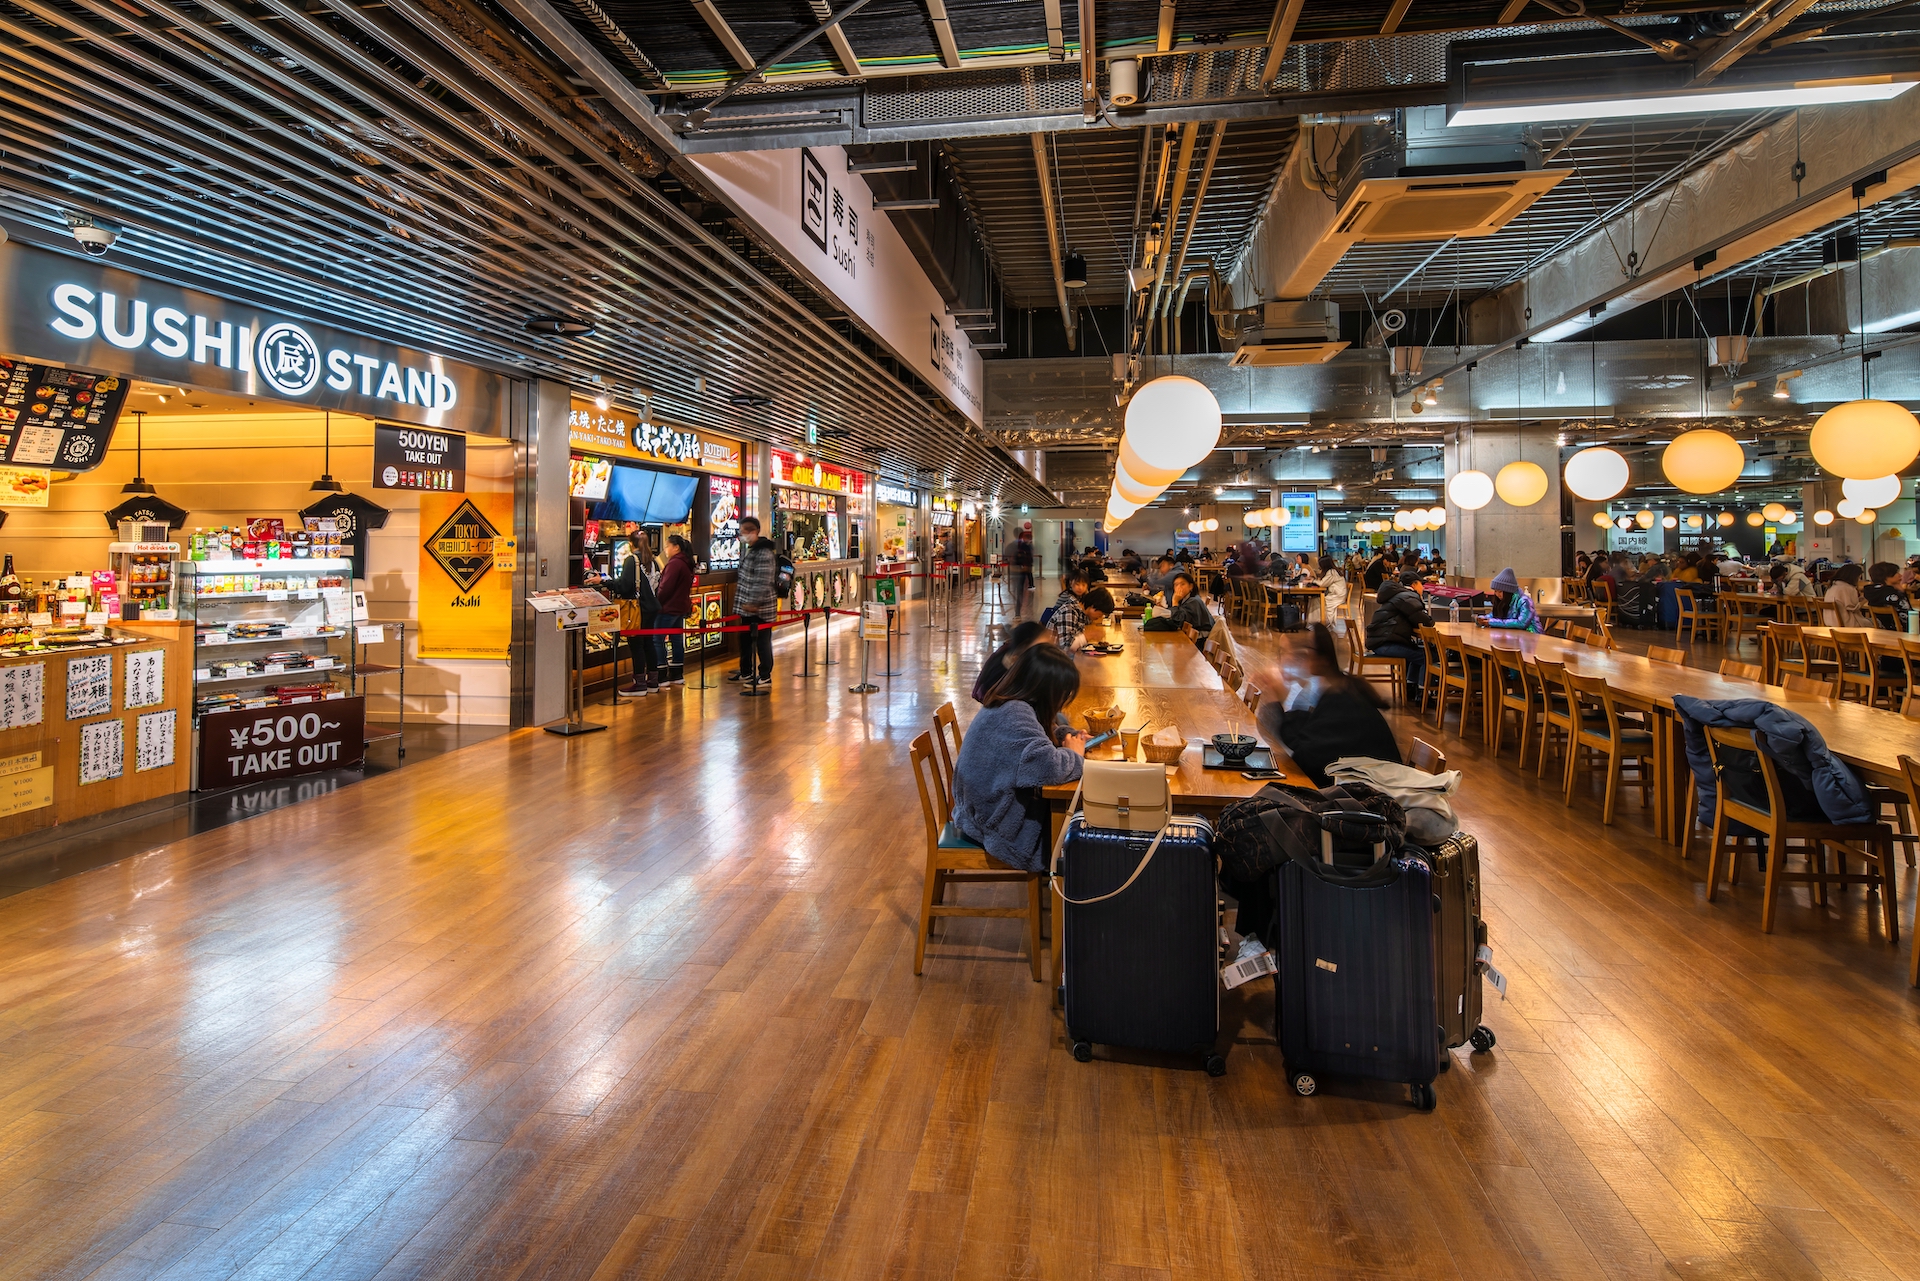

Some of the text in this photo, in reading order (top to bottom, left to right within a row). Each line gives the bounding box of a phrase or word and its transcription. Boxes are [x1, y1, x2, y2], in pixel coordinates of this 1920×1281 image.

[833, 186, 858, 246] 寿司
[833, 234, 856, 280] Sushi
[51, 283, 457, 411] SUSHI 辰 STAND
[70, 434, 96, 444] TATSU
[398, 429, 449, 453] 500YEN
[63, 454, 89, 463] SUSHI
[405, 450, 443, 465] TAKE OUT
[792, 465, 814, 487] ONE
[134, 509, 156, 518] TATSU
[331, 507, 354, 517] TATSU
[454, 523, 480, 539] TOKYO
[1618, 536, 1648, 546] 国内線
[450, 594, 481, 608] Asahi
[228, 741, 342, 777] TAKE OUT
